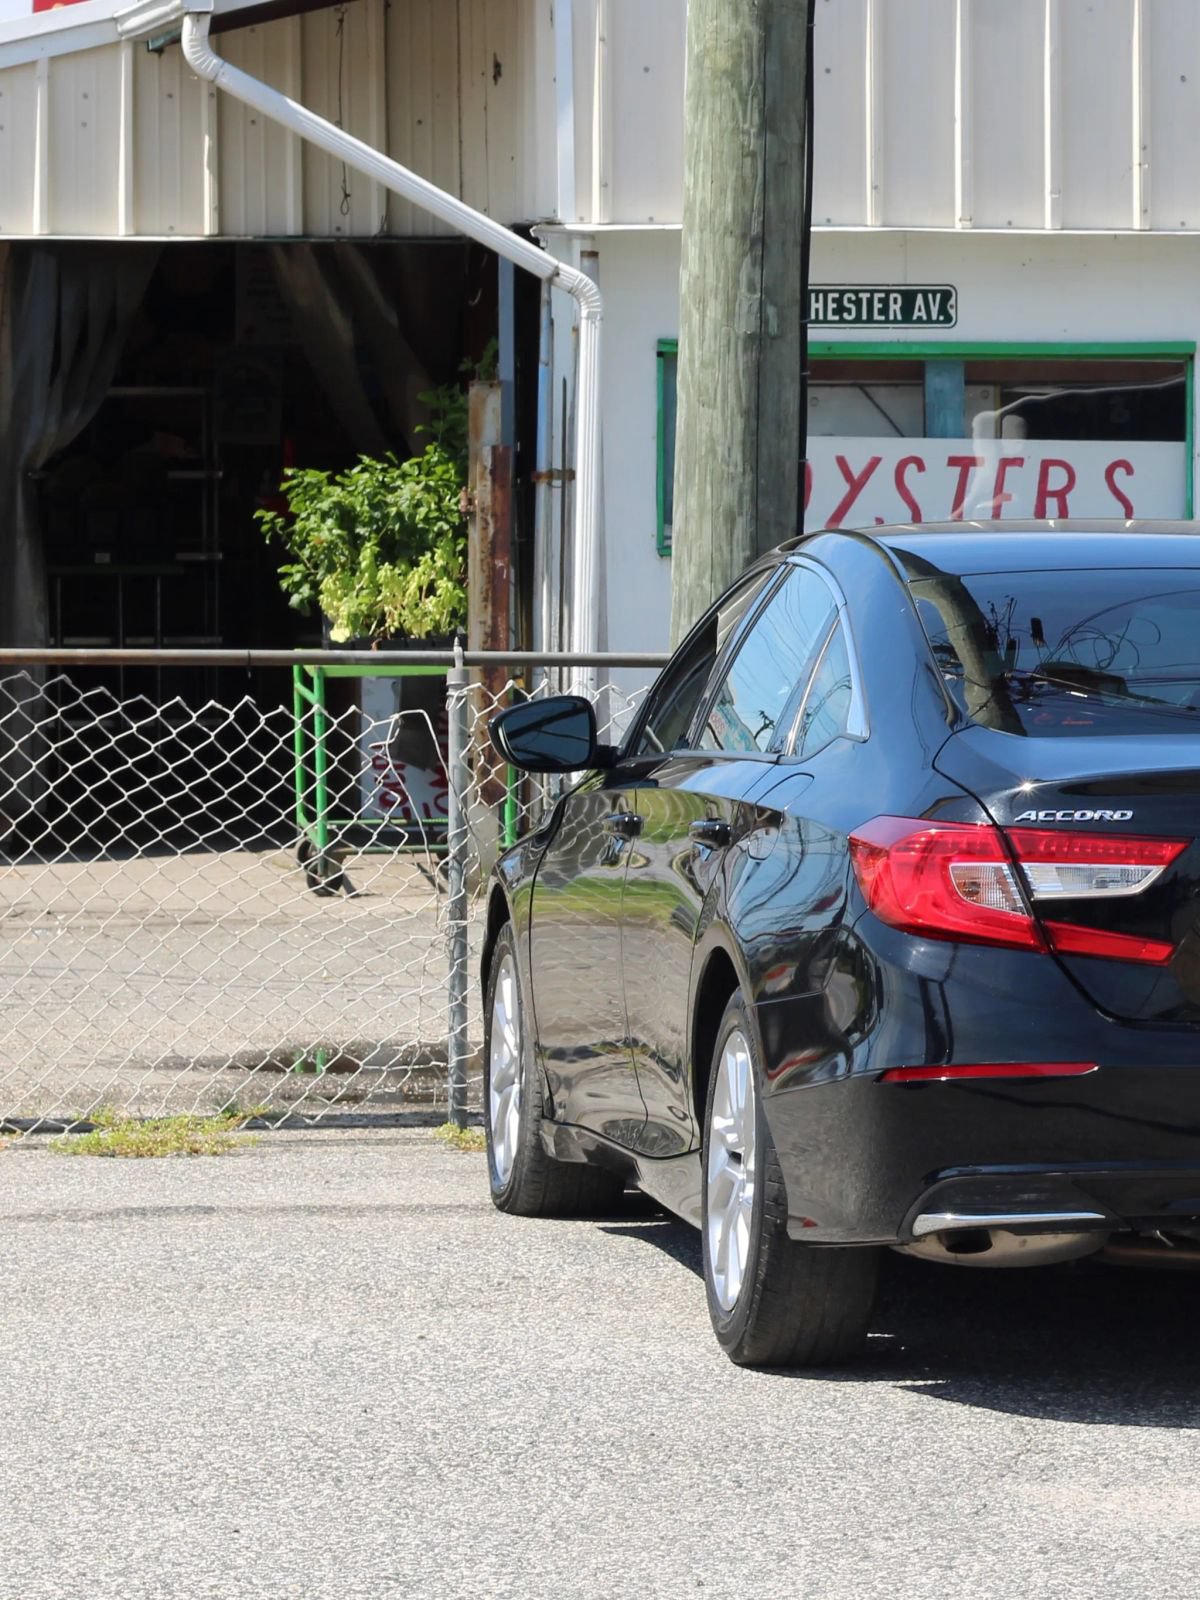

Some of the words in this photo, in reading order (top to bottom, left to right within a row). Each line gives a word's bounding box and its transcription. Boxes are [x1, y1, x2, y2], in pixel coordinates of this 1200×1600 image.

[912, 292, 945, 321] AV.
[804, 454, 1134, 530] YSTERS
[1014, 809, 1134, 822] ACCORD
